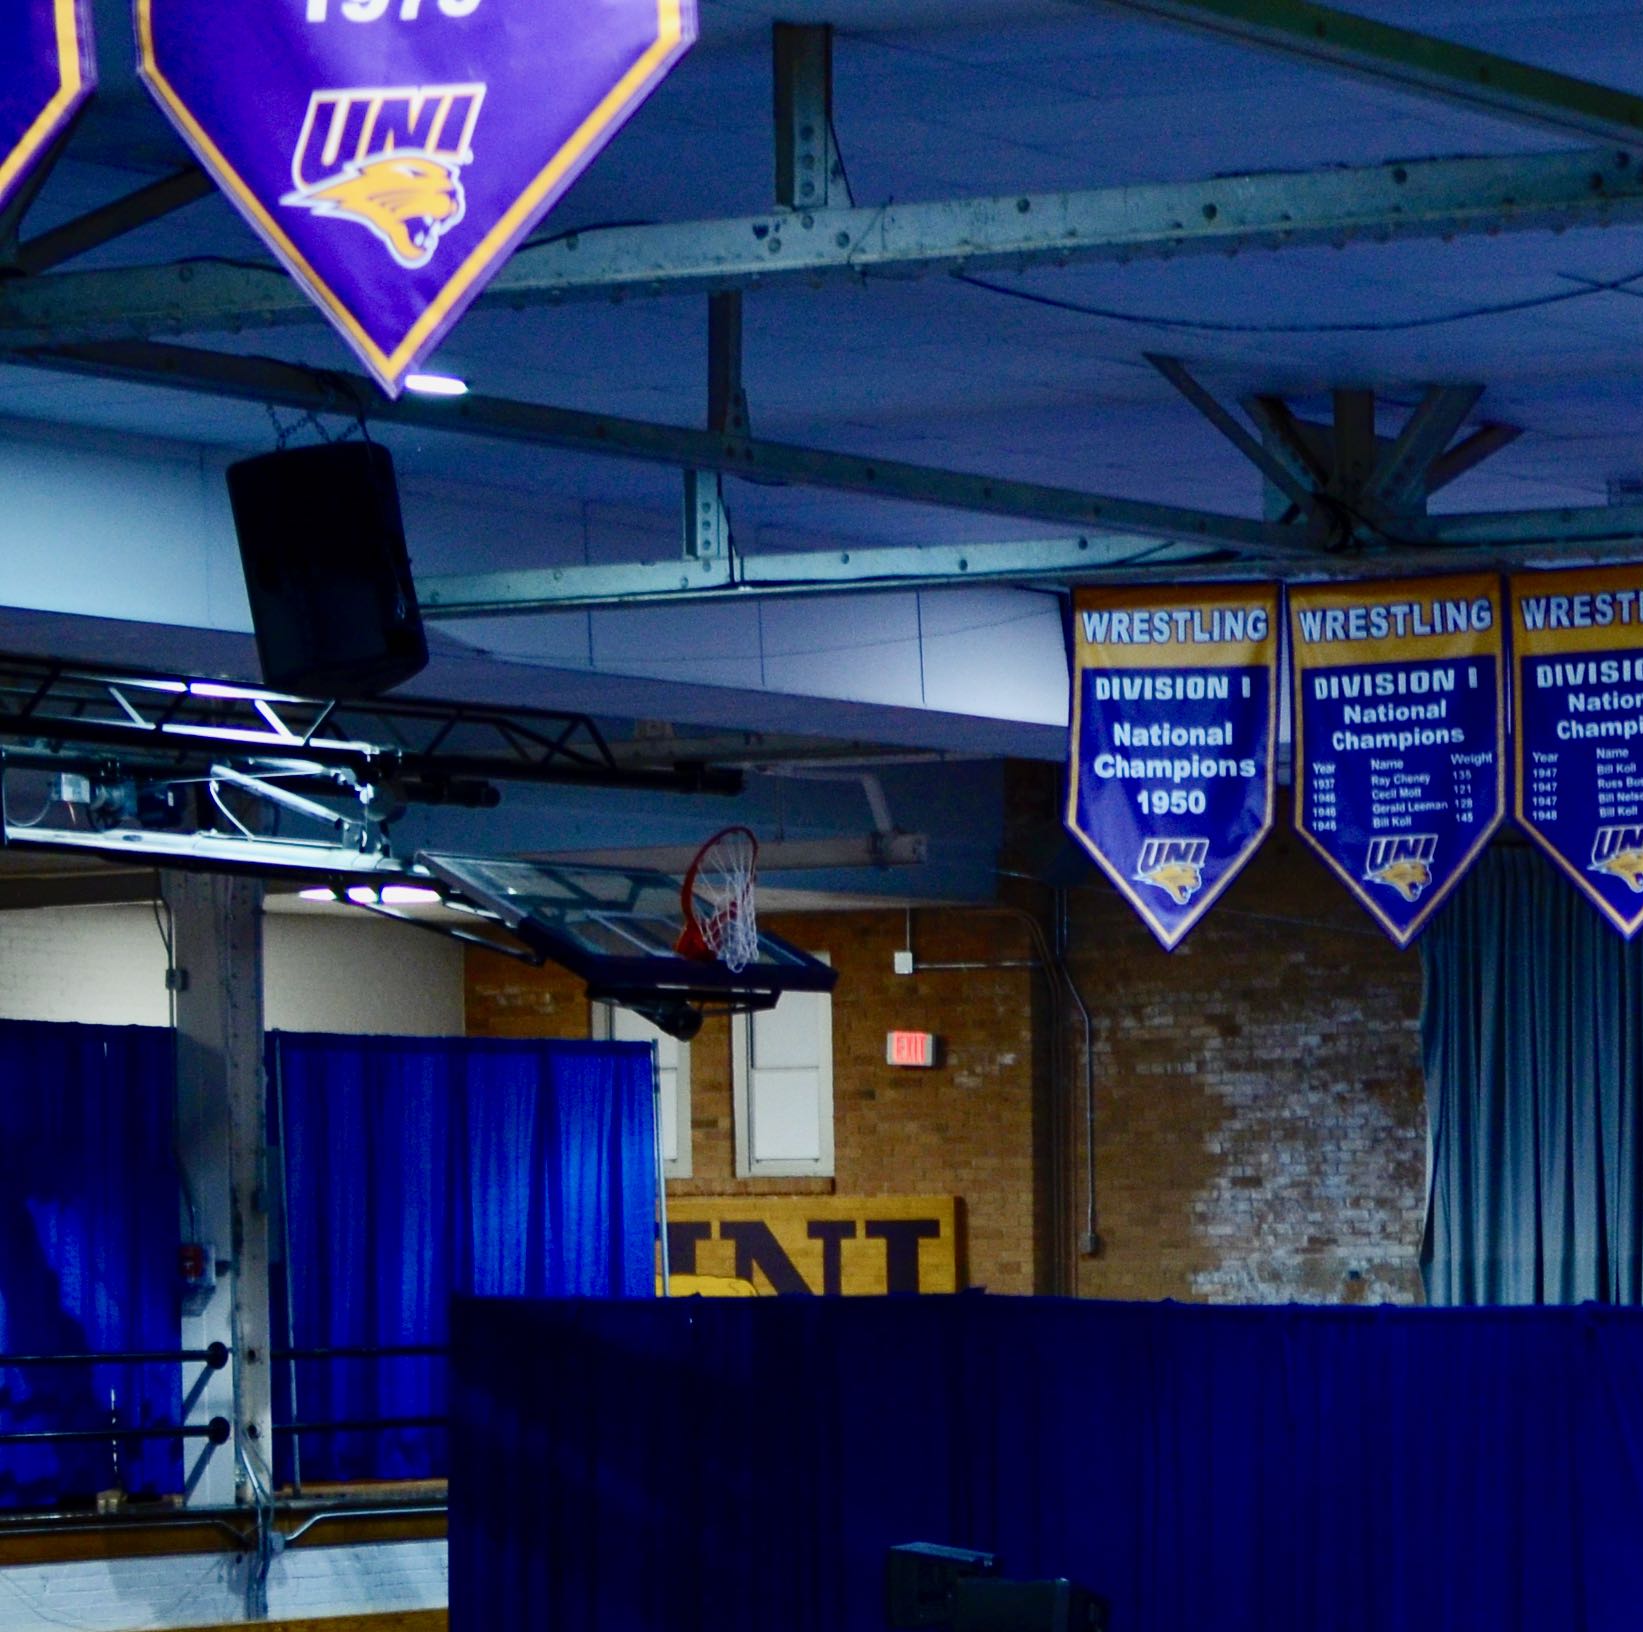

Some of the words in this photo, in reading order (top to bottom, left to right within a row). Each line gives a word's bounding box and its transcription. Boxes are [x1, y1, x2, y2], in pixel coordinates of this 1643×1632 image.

[291, 83, 487, 193] UNI
[1082, 609, 1269, 645] WRESTLING
[1299, 598, 1493, 641] WRESTLING
[1096, 676, 1228, 701] DIVISION
[1242, 676, 1250, 697] I
[1315, 669, 1455, 699] DIVISION
[1469, 667, 1477, 688] I
[1344, 700, 1447, 724] National
[1114, 722, 1232, 746] National
[1332, 727, 1465, 752] Champions
[1313, 763, 1335, 774] Year
[1371, 759, 1403, 770] Name
[1451, 752, 1492, 766] Weight
[1533, 752, 1558, 763] Year
[1596, 748, 1629, 759] Name
[1094, 754, 1256, 783] Champions
[1533, 769, 1557, 778] 1947
[1597, 764, 1613, 775] Bill
[1313, 779, 1335, 789] 1937
[1371, 775, 1390, 787] Ray
[1533, 783, 1557, 792] 1947
[1137, 790, 1206, 814] 1950
[1533, 797, 1557, 806] 1947
[1600, 807, 1615, 818] Bill
[1373, 818, 1389, 829] Bill
[1137, 838, 1209, 876] UNI
[1366, 834, 1438, 875] UNI
